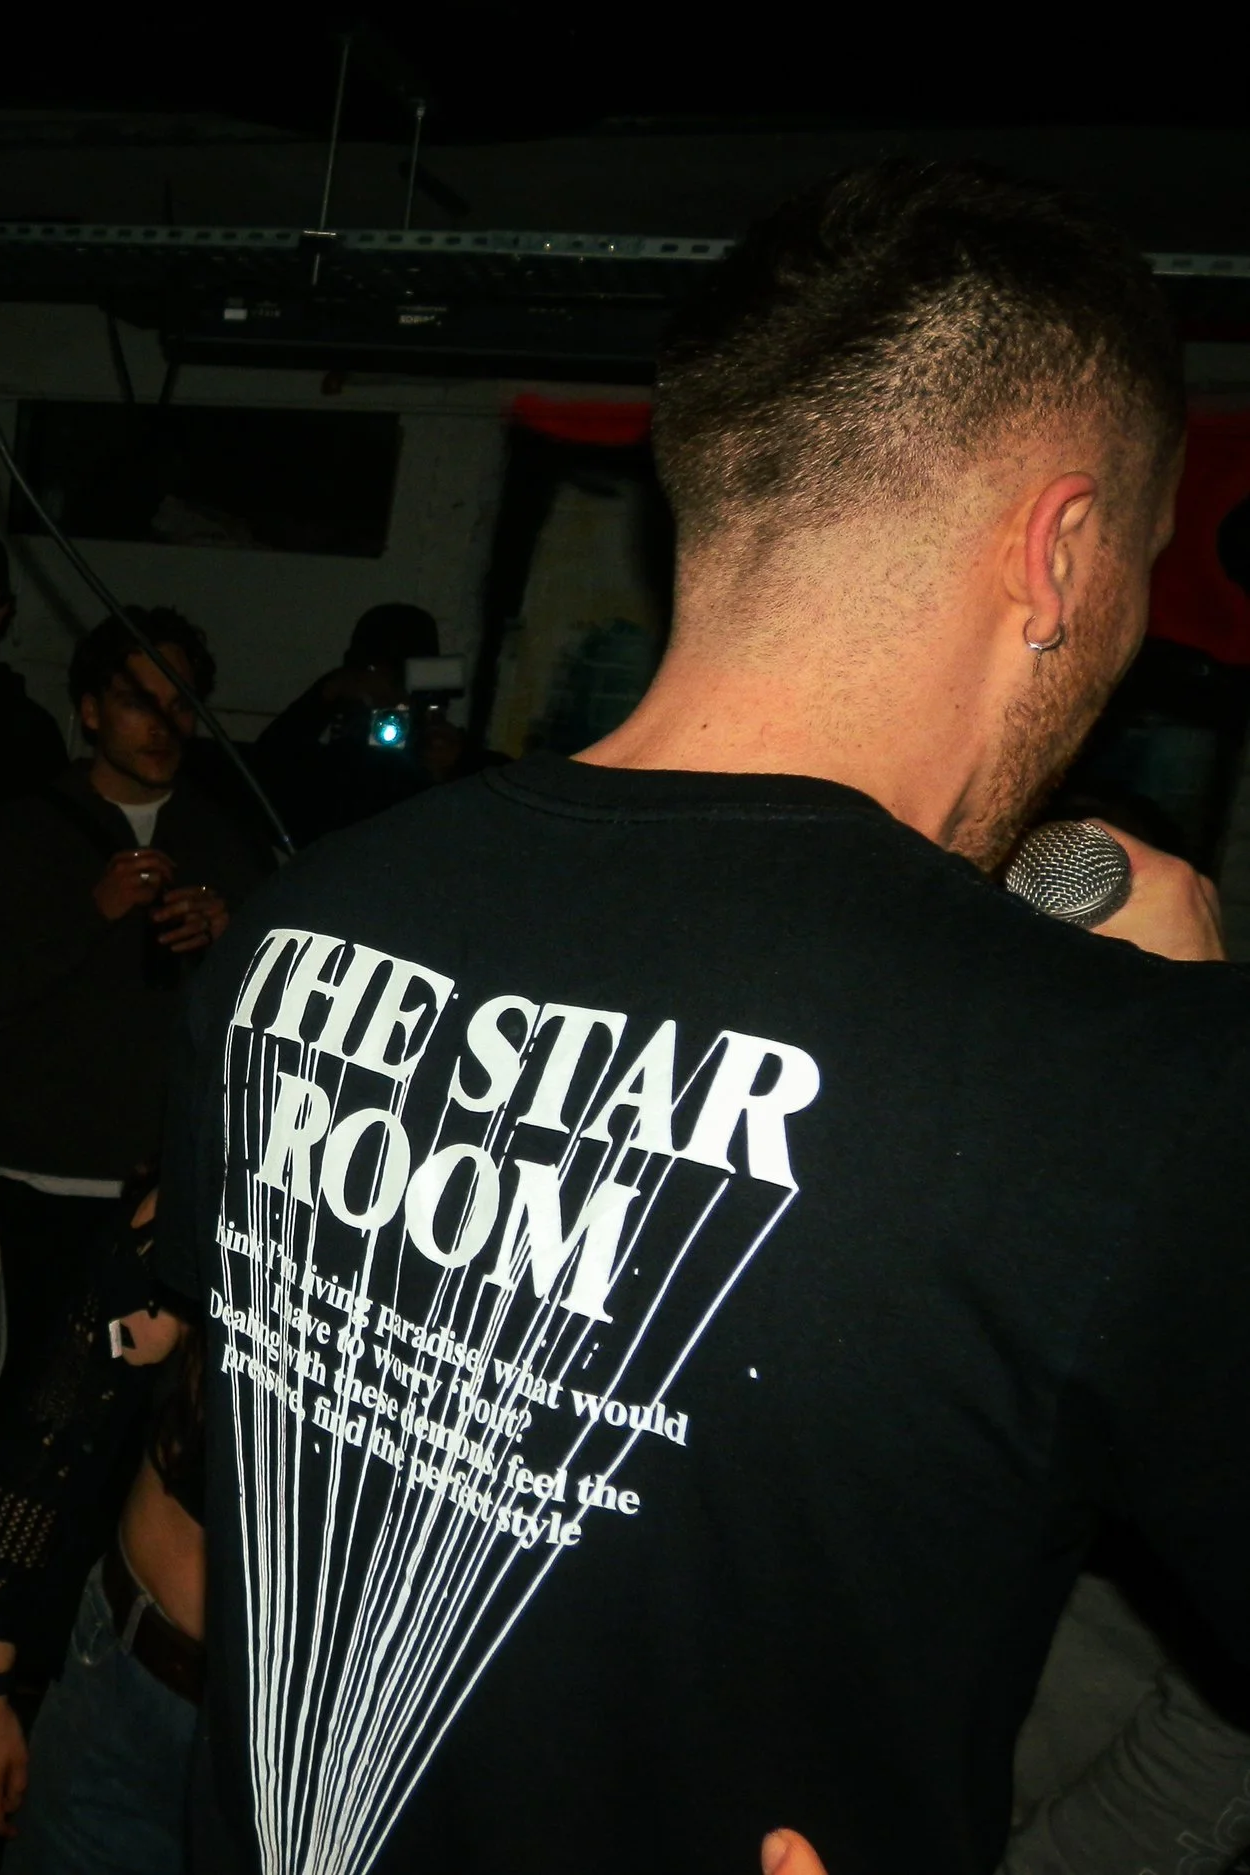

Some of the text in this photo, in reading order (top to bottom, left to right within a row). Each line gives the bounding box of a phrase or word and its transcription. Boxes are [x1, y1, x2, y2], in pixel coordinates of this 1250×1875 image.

[231, 928, 821, 1192] THE STAR
[254, 1071, 641, 1324] ROOM
[209, 1287, 280, 1362] Dealing
[283, 1342, 326, 1388] with
[333, 1367, 399, 1421] these
[504, 1454, 568, 1503] feel
[577, 1472, 641, 1515] the
[270, 1282, 284, 1315] I
[283, 1285, 332, 1345] have
[336, 1325, 366, 1360] to
[372, 1344, 444, 1408] worry
[299, 1257, 374, 1328] living
[493, 1357, 563, 1410] what
[571, 1389, 690, 1447] would
[311, 1396, 368, 1448] find
[371, 1427, 405, 1471] the
[407, 1455, 494, 1523] perfect
[495, 1505, 583, 1550] style
